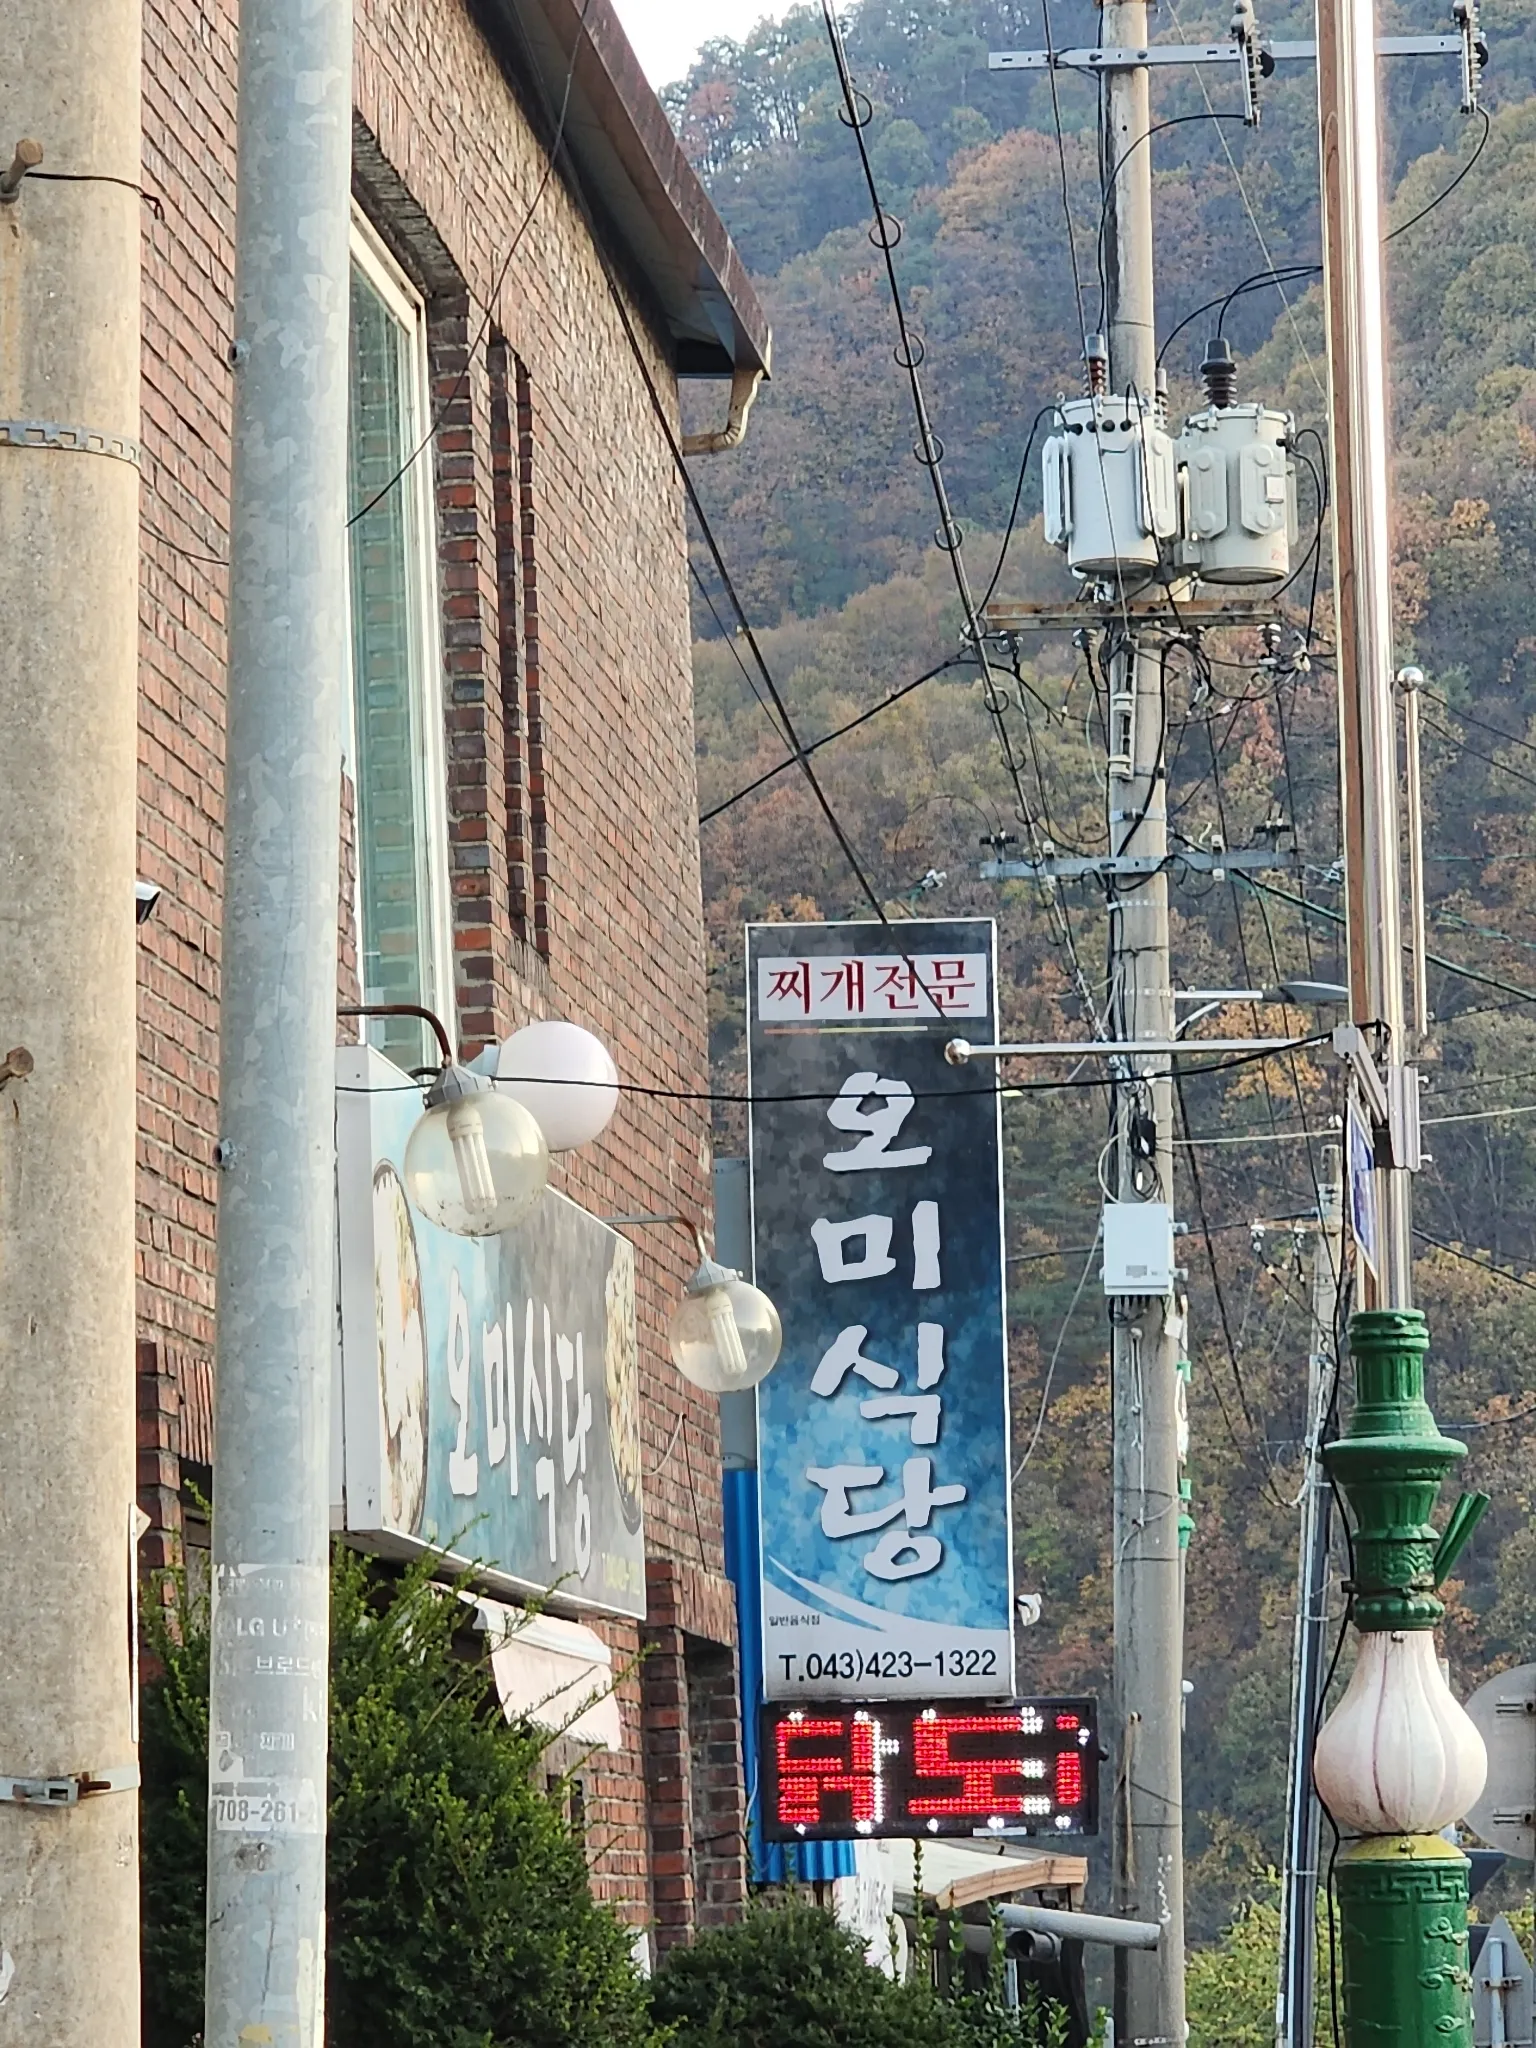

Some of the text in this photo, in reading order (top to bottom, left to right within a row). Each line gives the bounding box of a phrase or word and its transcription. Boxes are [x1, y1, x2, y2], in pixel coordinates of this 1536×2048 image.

[766, 960, 976, 1015] 찌개전문
[806, 1071, 966, 1581] 오미식당
[447, 1266, 593, 1580] 오미식당
[769, 1614, 820, 1626] 일반음식점
[779, 1649, 997, 1682] T.043)423-1322
